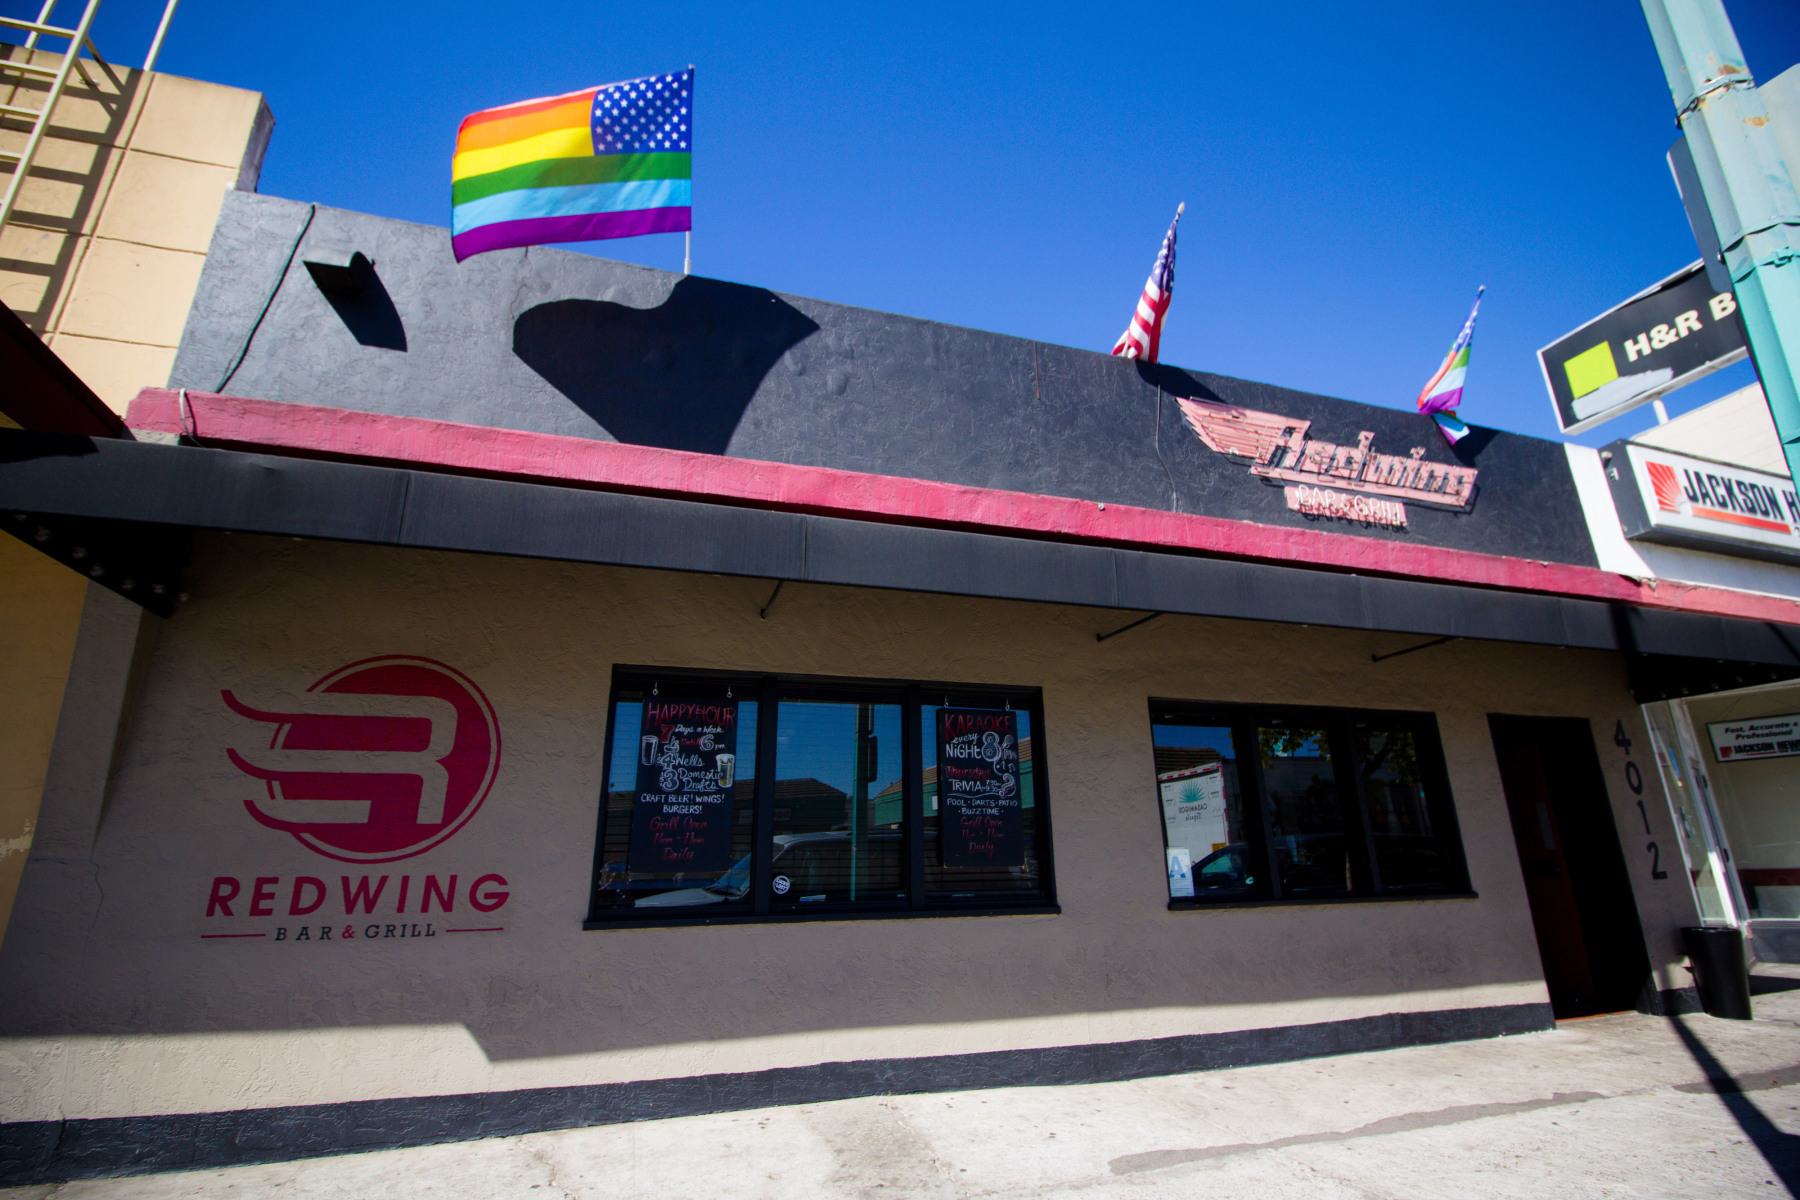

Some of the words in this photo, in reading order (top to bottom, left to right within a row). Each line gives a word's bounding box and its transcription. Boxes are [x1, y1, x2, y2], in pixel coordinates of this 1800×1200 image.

[1623, 310, 1703, 362] H&R
[1683, 468, 1784, 521] JACKSON
[945, 713, 1011, 738] KARAOKE
[1748, 722, 1790, 731] Accurate
[659, 724, 675, 743] 7
[951, 732, 980, 744] every
[1735, 729, 1793, 740] Professional
[699, 734, 714, 751] 6
[1734, 742, 1775, 753] JACKSON
[676, 753, 704, 767] Wells
[678, 768, 723, 780] Domestic
[945, 765, 992, 780] Thursdays
[682, 777, 718, 792] Drafts
[948, 778, 983, 792] TRIVIA
[641, 793, 666, 803] CRAFT
[696, 793, 725, 803] WINGS!
[947, 798, 967, 806] POOL
[972, 799, 995, 807] DARTS
[999, 799, 1018, 807] PATIO
[1613, 719, 1668, 880] 4012
[663, 805, 703, 814] BURGERS!
[649, 816, 680, 831] Grill
[663, 847, 694, 864] Daily
[968, 841, 995, 858] Daily
[205, 873, 510, 917] REDWING
[274, 925, 332, 941] BAR
[364, 923, 436, 939] GRILL
